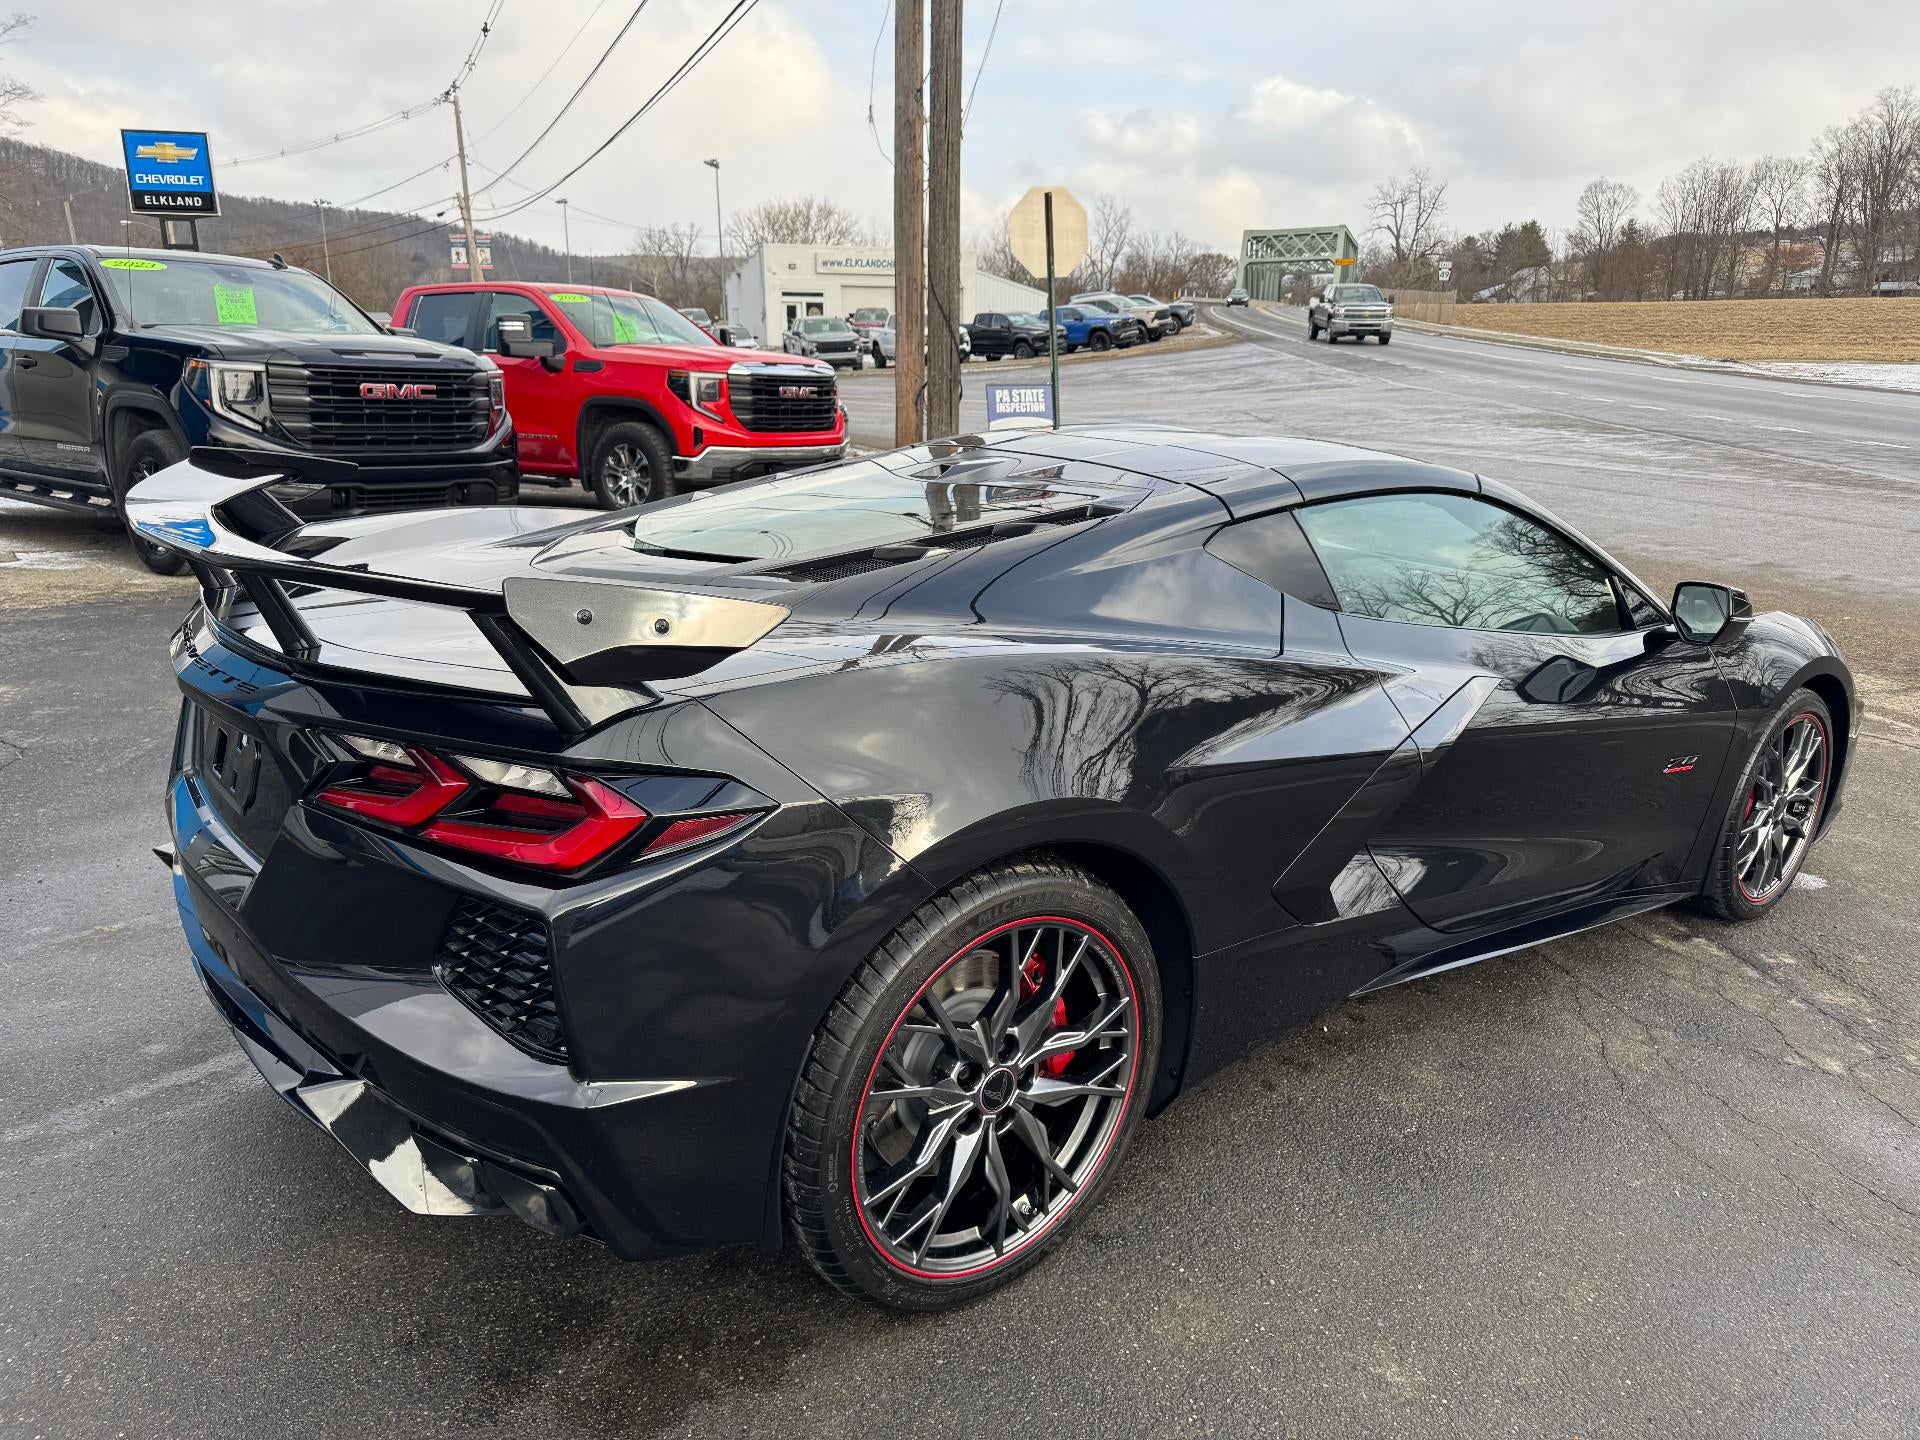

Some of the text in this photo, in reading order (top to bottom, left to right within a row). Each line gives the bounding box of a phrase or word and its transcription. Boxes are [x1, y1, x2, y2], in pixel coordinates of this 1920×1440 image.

[135, 173, 204, 186] CHEVROLET
[144, 195, 202, 207] ELKLAND
[1439, 271, 1449, 279] 49
[360, 383, 437, 399] GMC
[779, 386, 818, 398] GMC
[996, 389, 1045, 403] PA STATE
[996, 402, 1046, 413] INSPECTION
[56, 443, 91, 452] SIERRA
